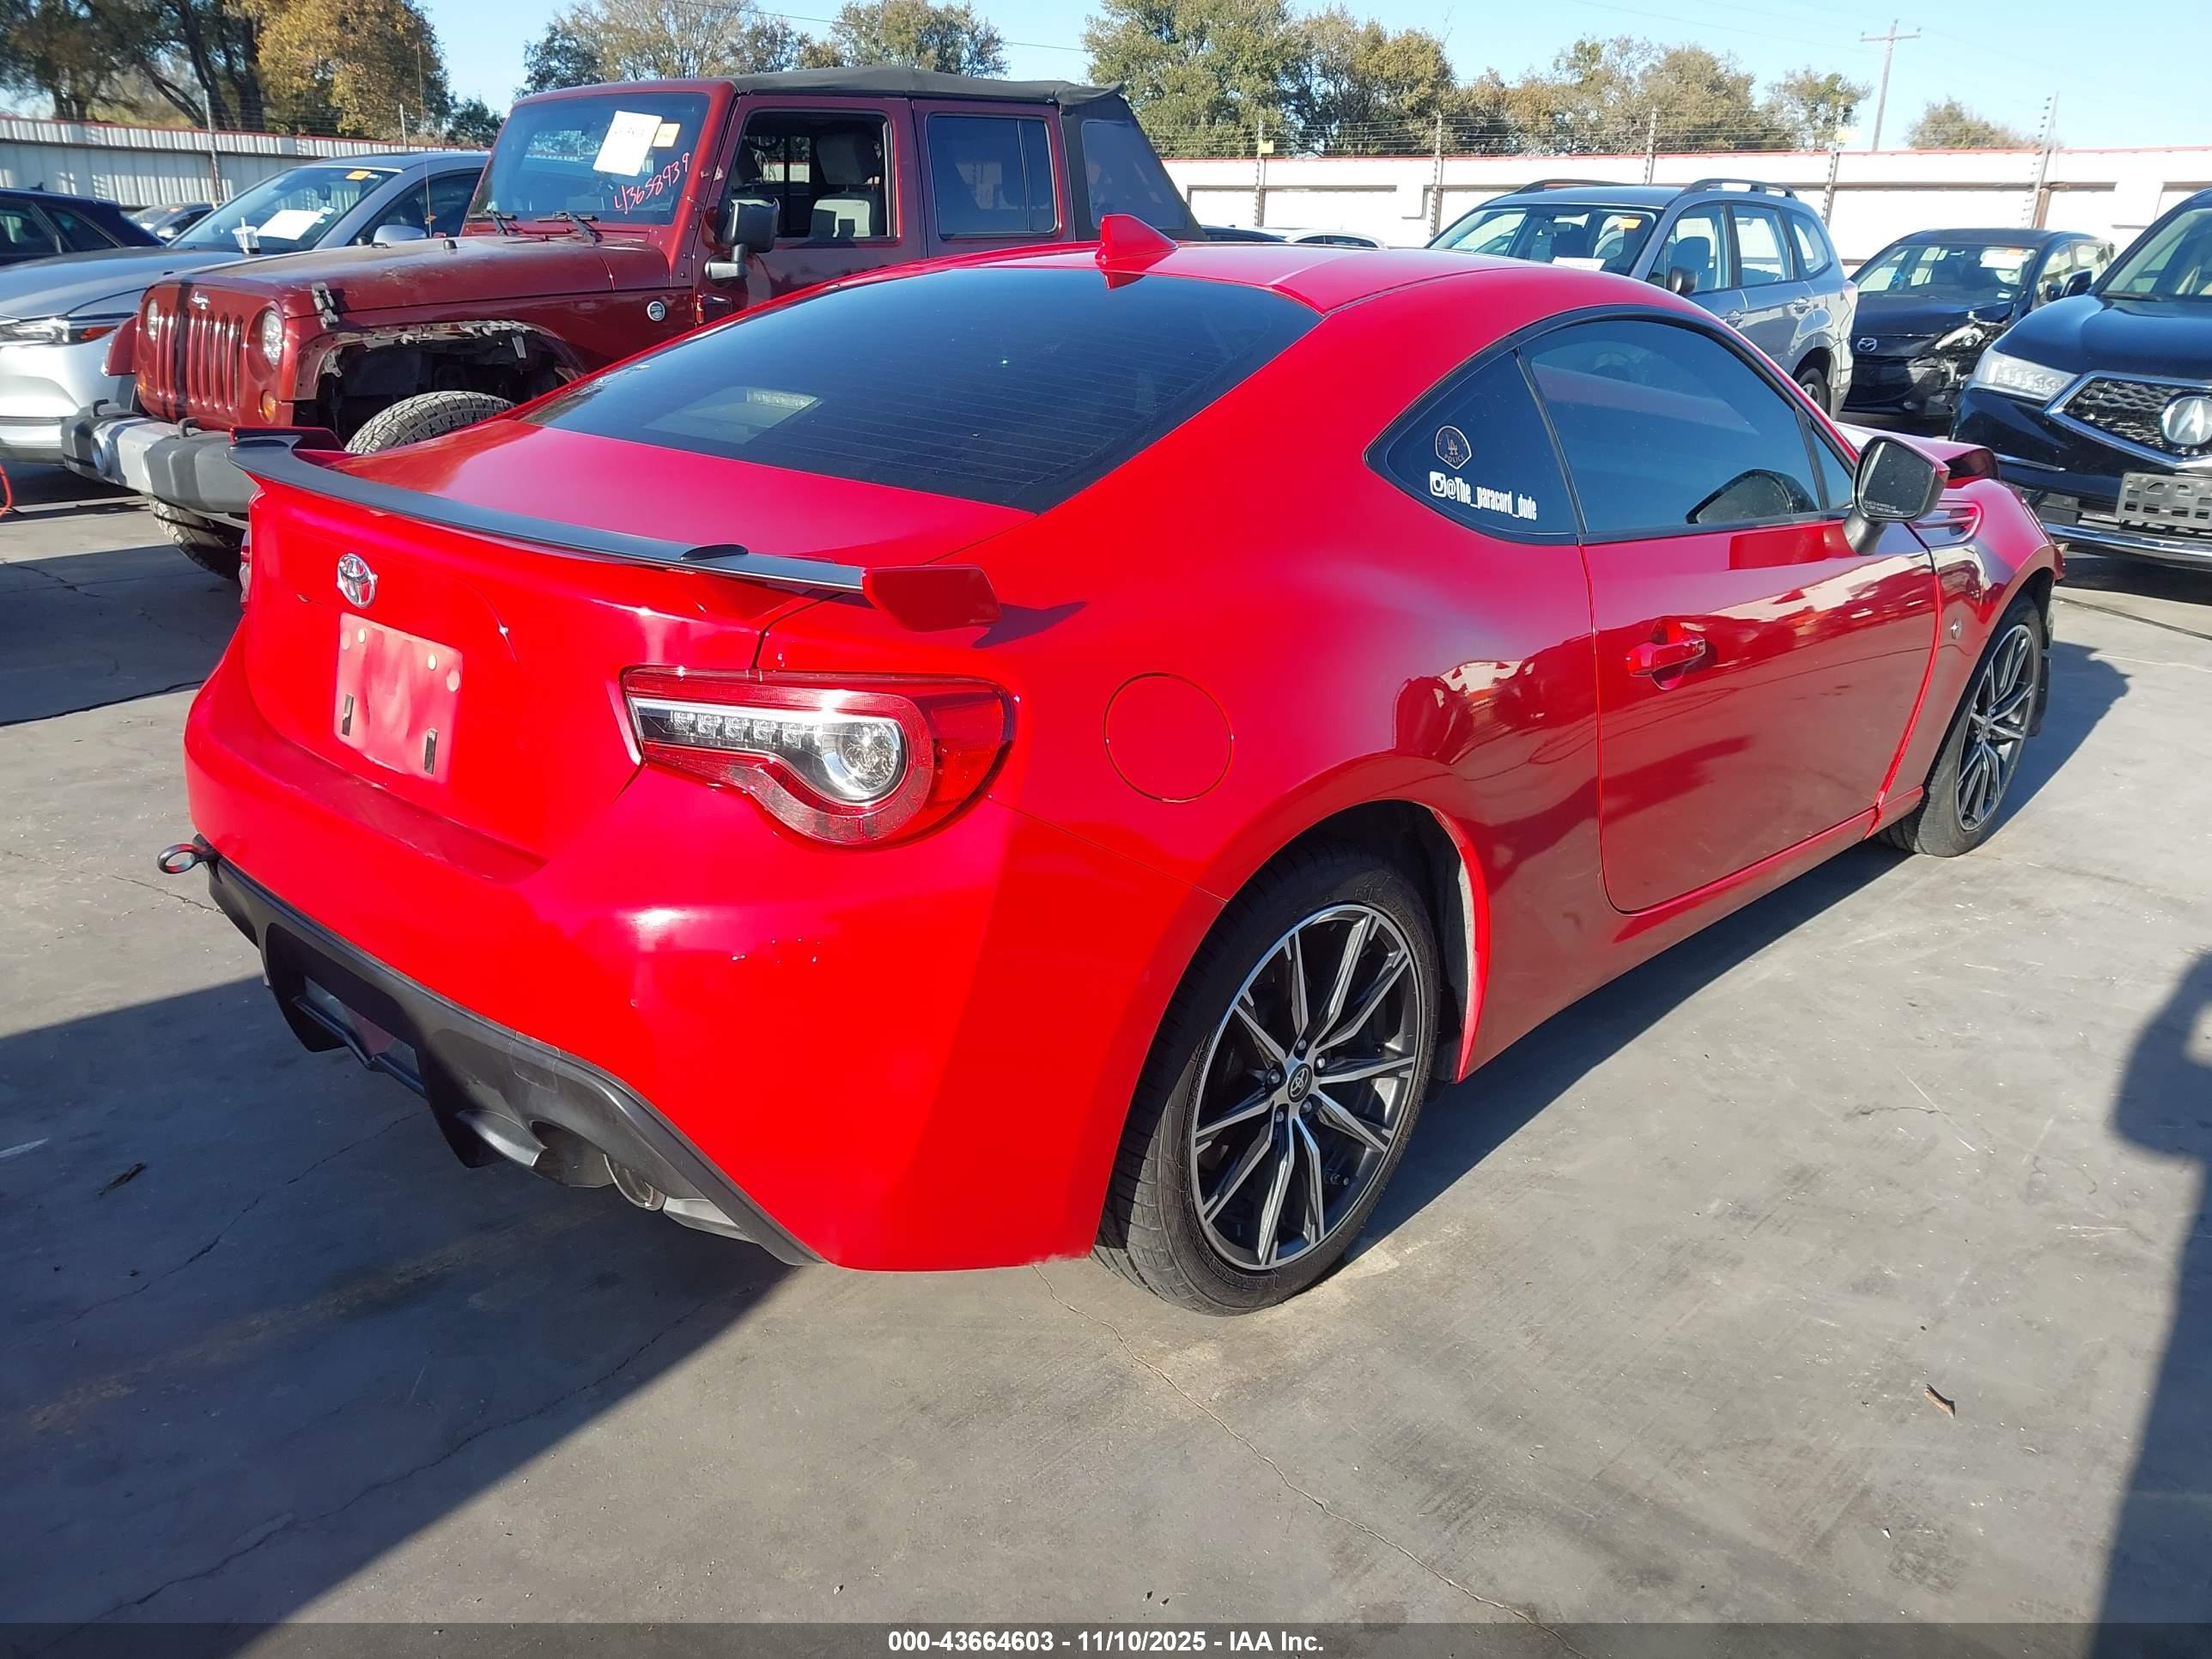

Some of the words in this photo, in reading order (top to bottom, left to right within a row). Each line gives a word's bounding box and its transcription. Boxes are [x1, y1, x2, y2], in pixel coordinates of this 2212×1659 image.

[614, 153, 690, 214] 43658939
[1443, 453, 1465, 464] POLICE
[1446, 477, 1537, 520] @The_paracord_dude
